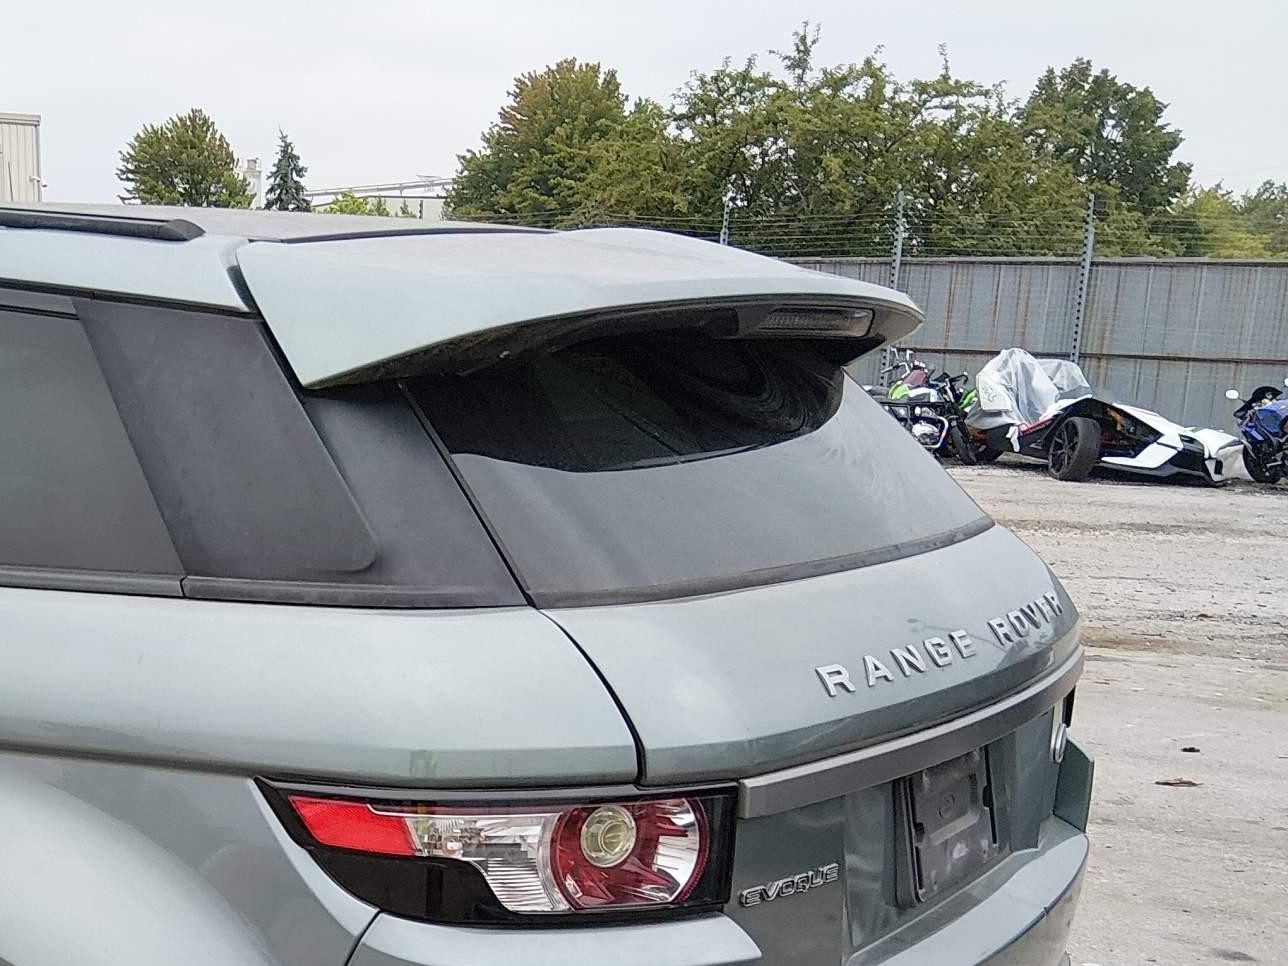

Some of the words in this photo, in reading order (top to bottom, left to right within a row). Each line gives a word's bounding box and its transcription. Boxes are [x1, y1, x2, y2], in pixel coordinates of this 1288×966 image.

[815, 629, 976, 697] RANGE
[987, 591, 1064, 647] ROVER
[740, 862, 839, 907] EVOQUE
